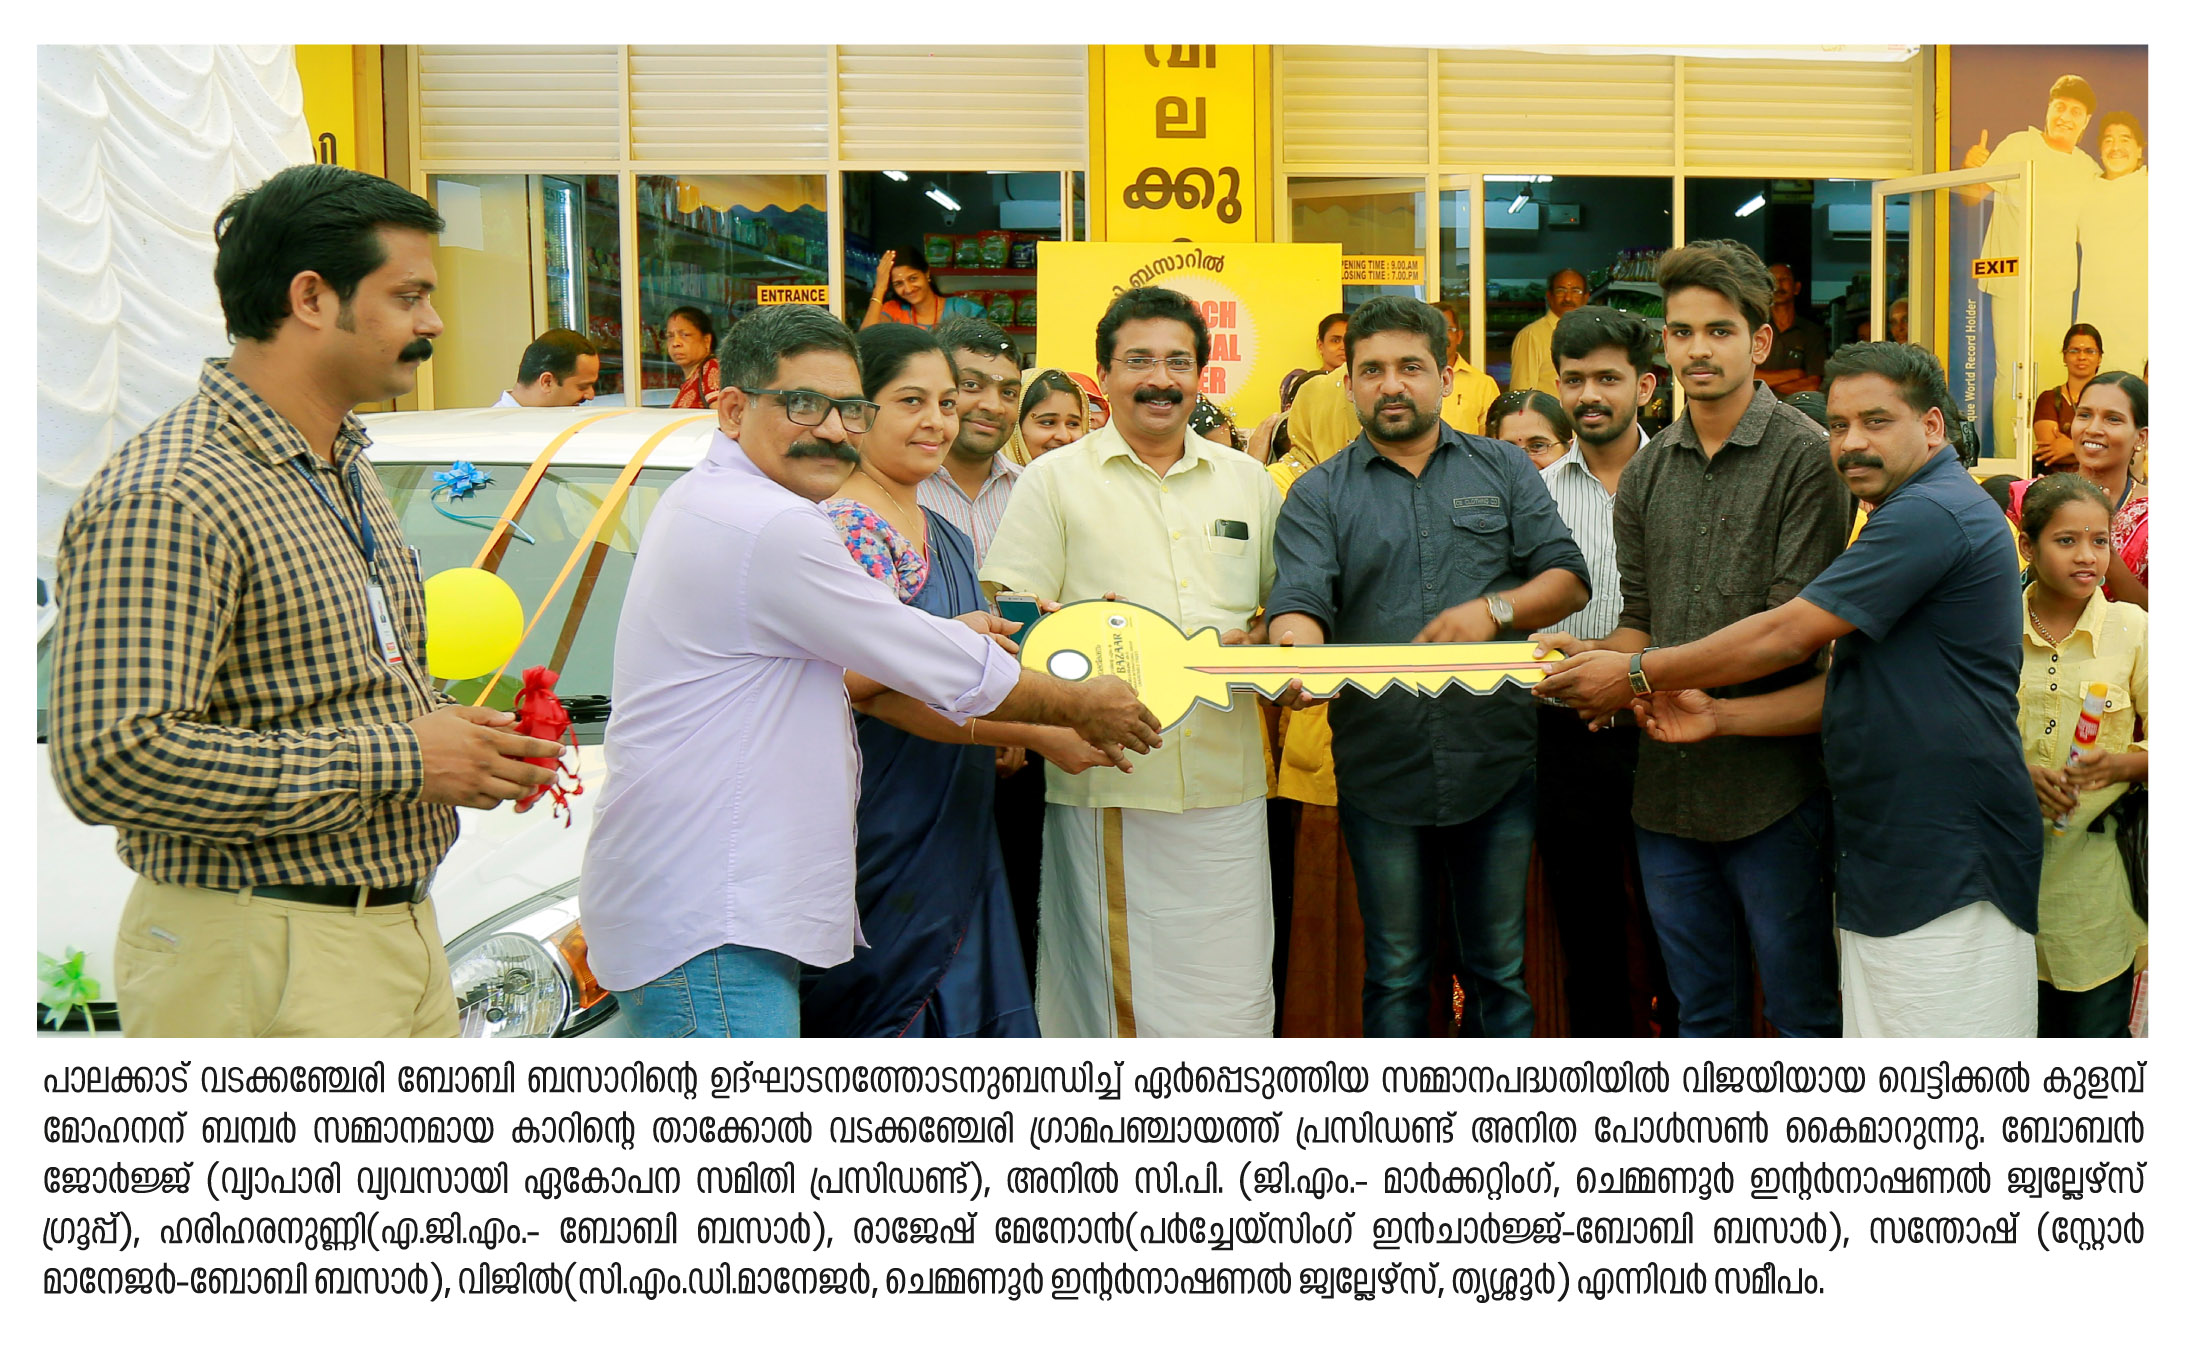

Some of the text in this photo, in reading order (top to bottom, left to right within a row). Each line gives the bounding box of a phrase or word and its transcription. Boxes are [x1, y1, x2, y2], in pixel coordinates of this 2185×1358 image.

[1368, 260, 1385, 270] TIME
[1368, 271, 1386, 280] TIME
[1974, 259, 2018, 275] EXIT
[761, 289, 825, 302] ENTRANCE
[1965, 299, 1977, 333] Holder
[1208, 333, 1242, 361] AL
[1965, 335, 1977, 369] Record
[1965, 372, 1977, 402] World
[1112, 633, 1126, 674] BAZAAR
